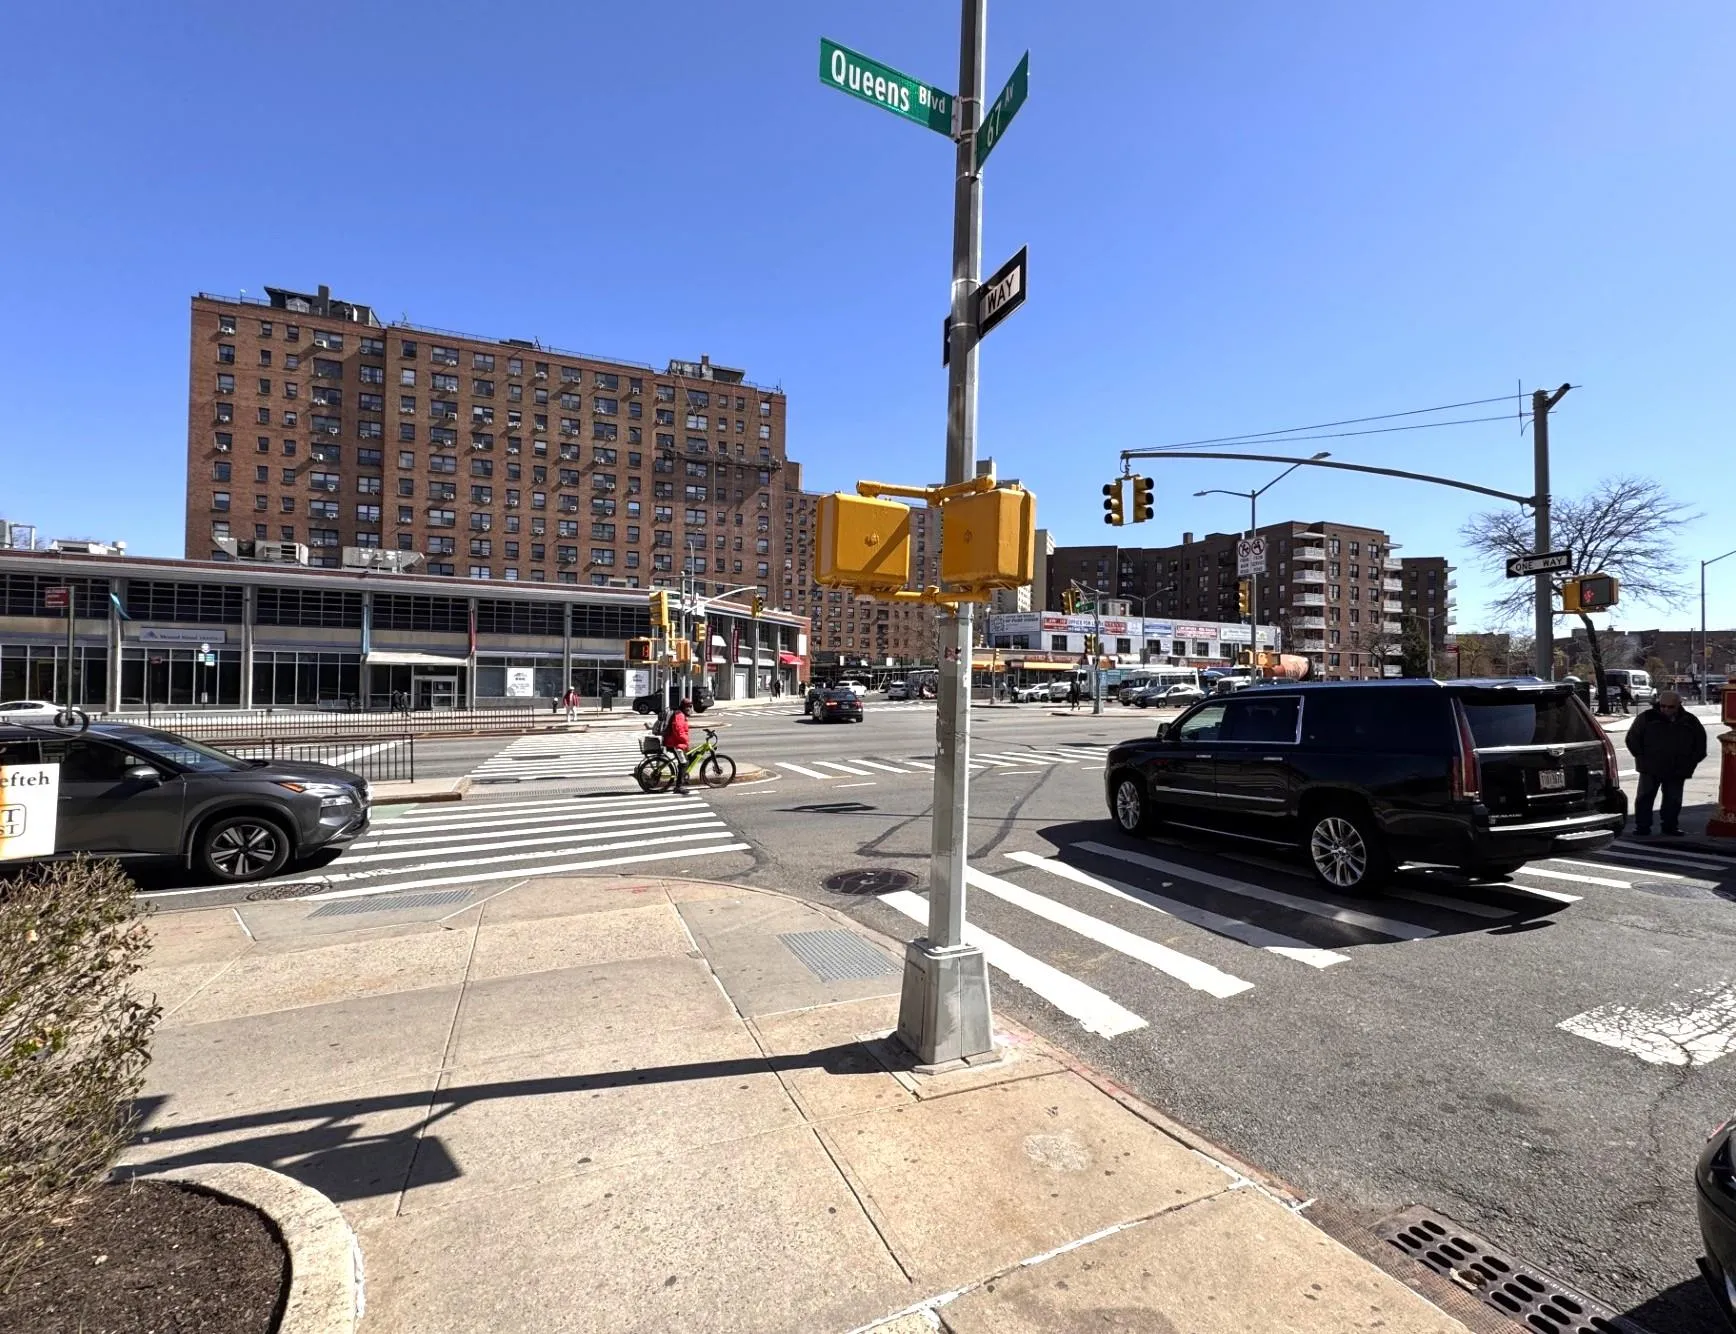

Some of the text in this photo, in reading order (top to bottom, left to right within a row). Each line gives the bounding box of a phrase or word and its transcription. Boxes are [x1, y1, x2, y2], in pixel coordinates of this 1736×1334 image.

[831, 50, 946, 114] Queens Blvd
[986, 102, 1002, 146] 67
[987, 273, 1015, 314] WAY
[1515, 557, 1562, 571] ONE WAY
